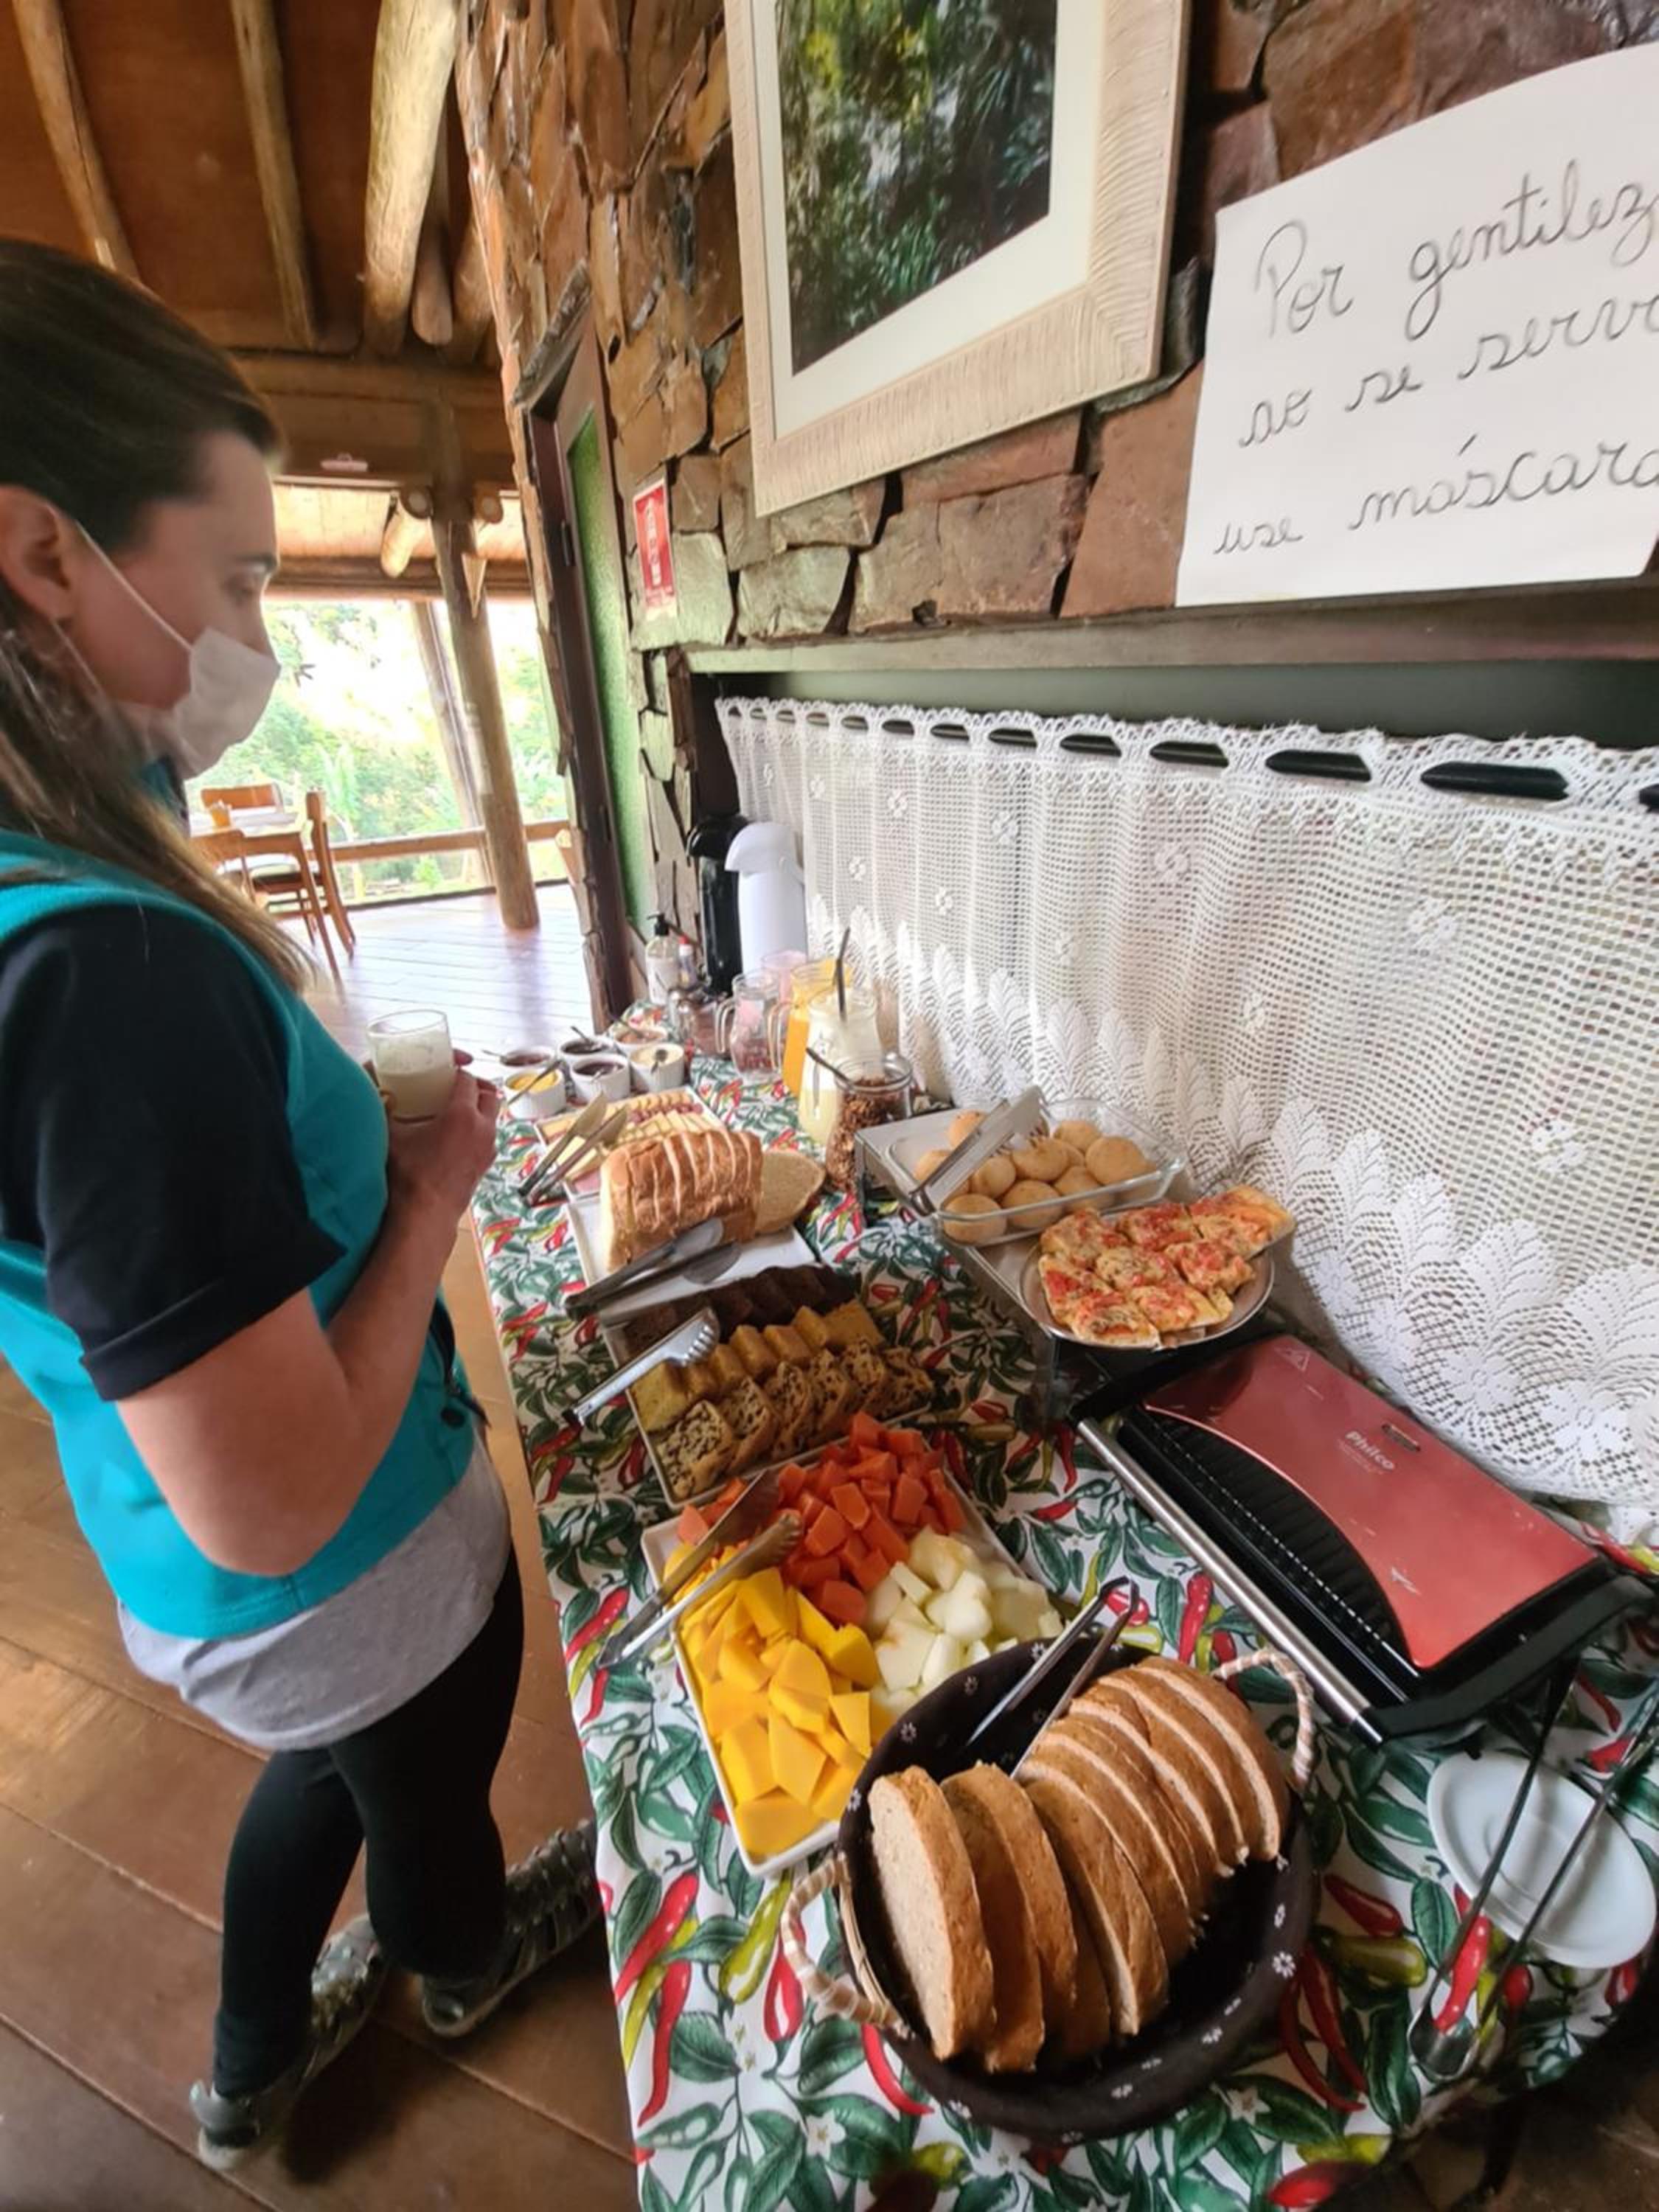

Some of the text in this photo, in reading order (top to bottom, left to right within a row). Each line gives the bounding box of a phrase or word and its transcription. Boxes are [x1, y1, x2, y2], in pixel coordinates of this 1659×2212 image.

[1254, 220, 1353, 338] Por
[1345, 366, 1423, 412] se
[1214, 517, 1304, 555] use
[1345, 1430, 1395, 1470] Philco
